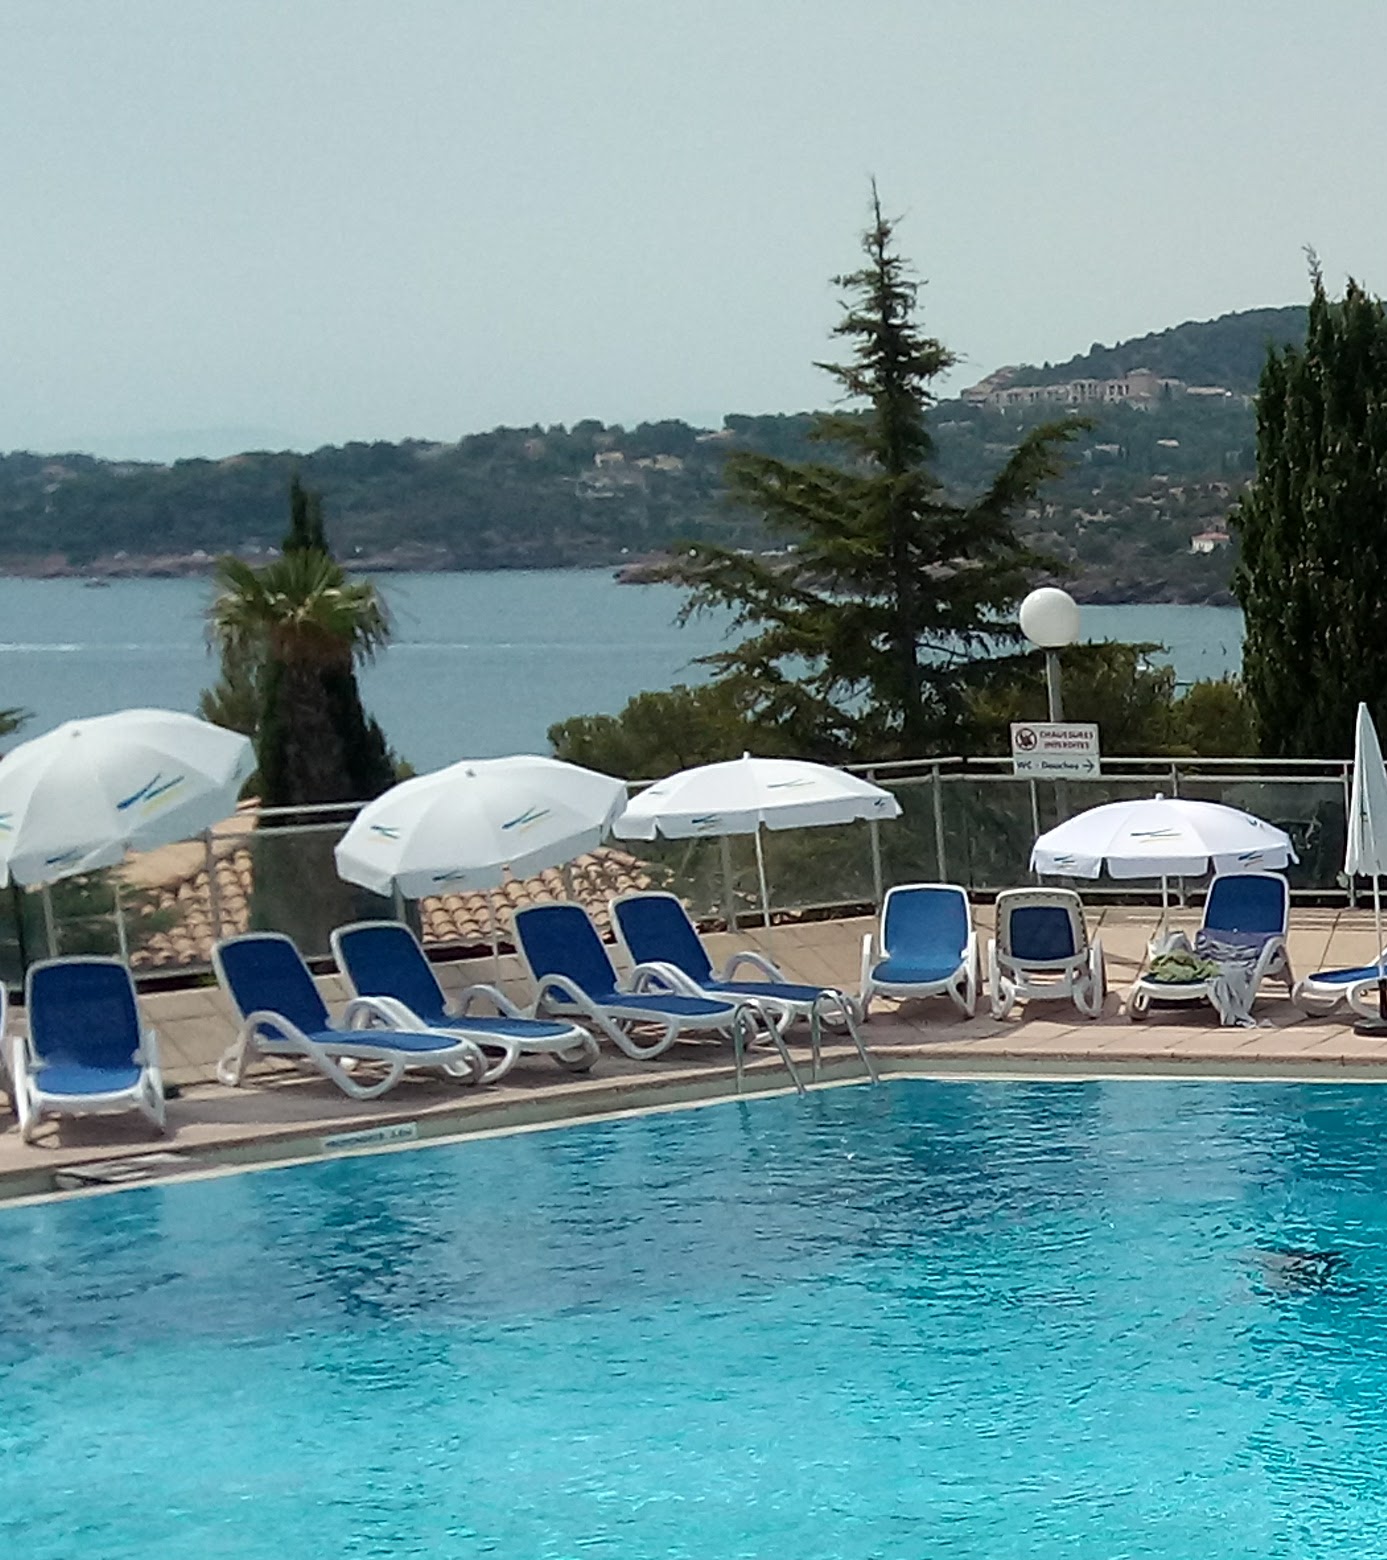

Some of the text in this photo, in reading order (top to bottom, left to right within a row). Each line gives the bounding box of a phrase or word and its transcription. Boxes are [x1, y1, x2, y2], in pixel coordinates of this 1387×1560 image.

[1040, 731, 1094, 739] CHAUSSURES
[1044, 742, 1090, 750] INTERDITES
[1017, 761, 1032, 770] WC
[1042, 761, 1079, 770] Douches
